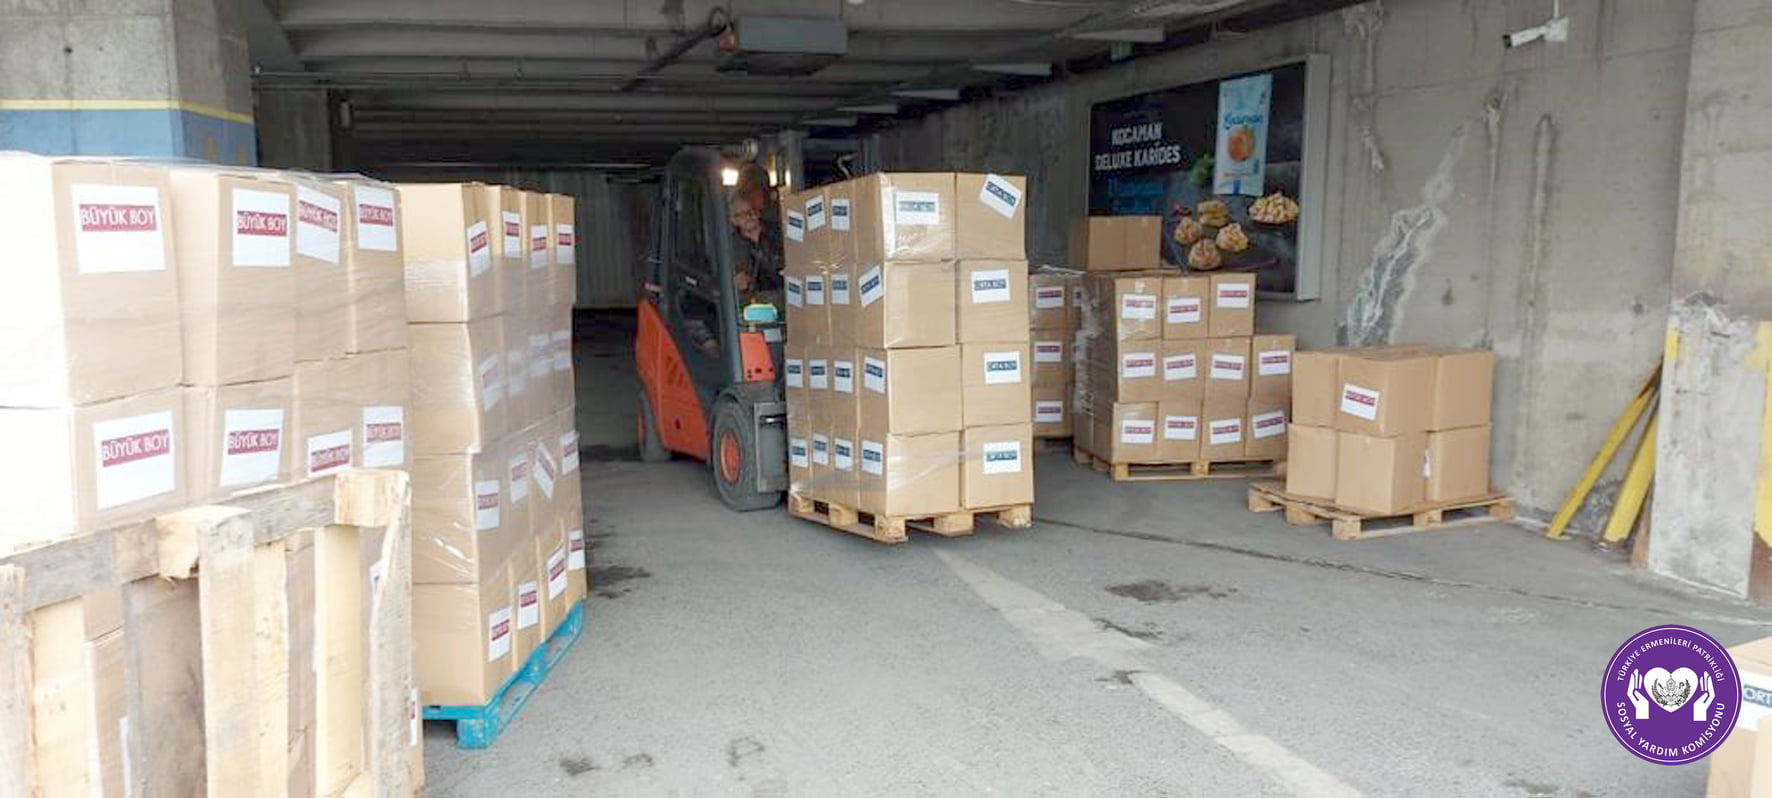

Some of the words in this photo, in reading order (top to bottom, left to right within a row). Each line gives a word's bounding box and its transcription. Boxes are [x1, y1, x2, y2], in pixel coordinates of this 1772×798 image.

[1111, 122, 1163, 146] KOCAMAN
[1094, 151, 1133, 171] DELUXE
[129, 207, 155, 226] BOY
[267, 215, 287, 233] BOY
[143, 433, 169, 453] BOY
[259, 431, 278, 449] BOY
